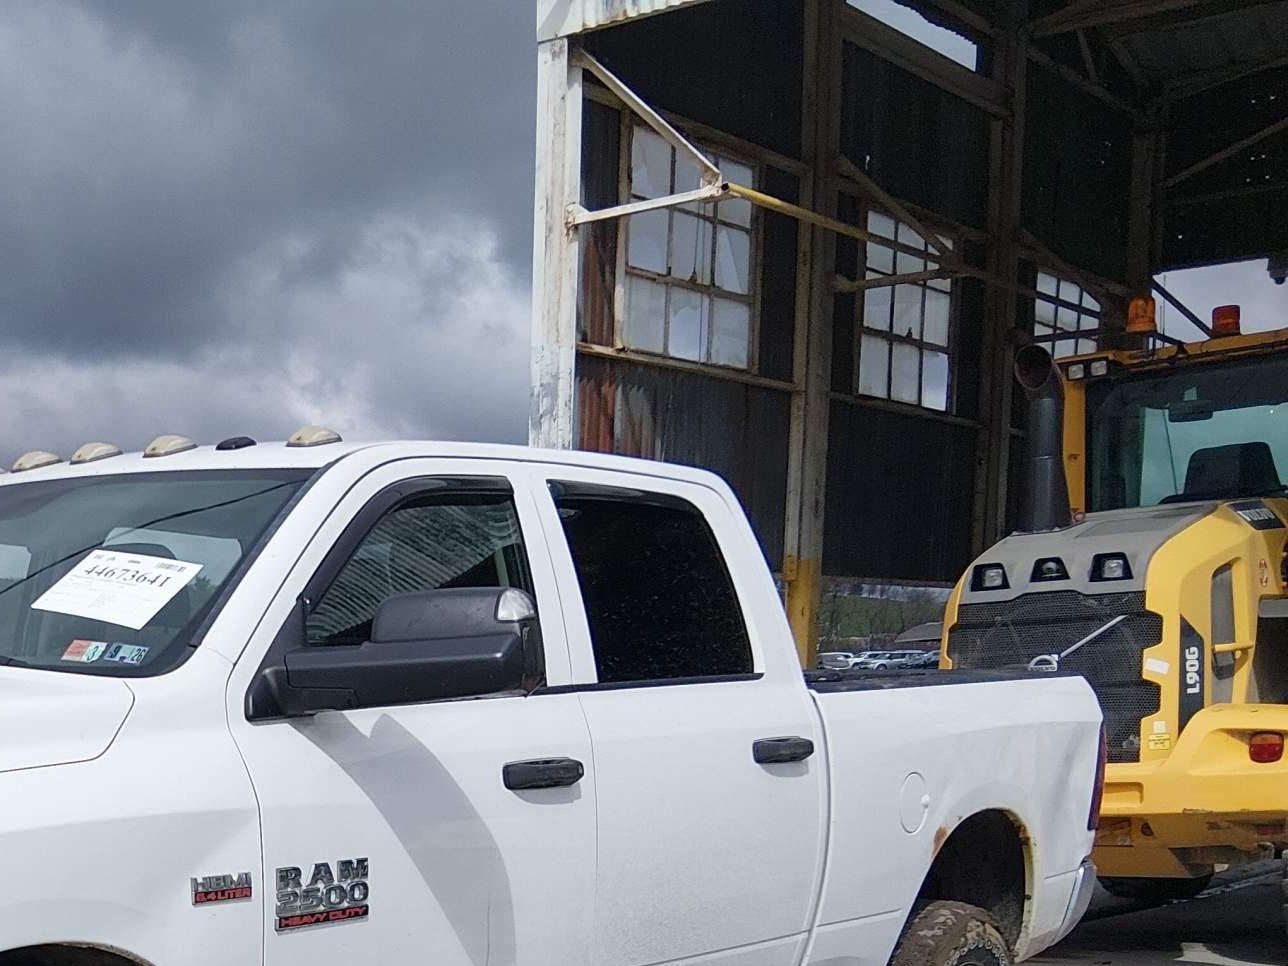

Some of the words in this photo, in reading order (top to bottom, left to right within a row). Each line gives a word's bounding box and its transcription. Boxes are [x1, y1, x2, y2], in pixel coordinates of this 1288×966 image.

[84, 564, 173, 587] 44673641
[131, 647, 146, 662] 26
[1185, 645, 1201, 695] L90G
[190, 872, 252, 892] HEMI
[275, 857, 369, 891] RAM
[275, 880, 369, 917] 2500
[281, 912, 327, 927] HEAVY
[328, 906, 366, 921] DUTY
